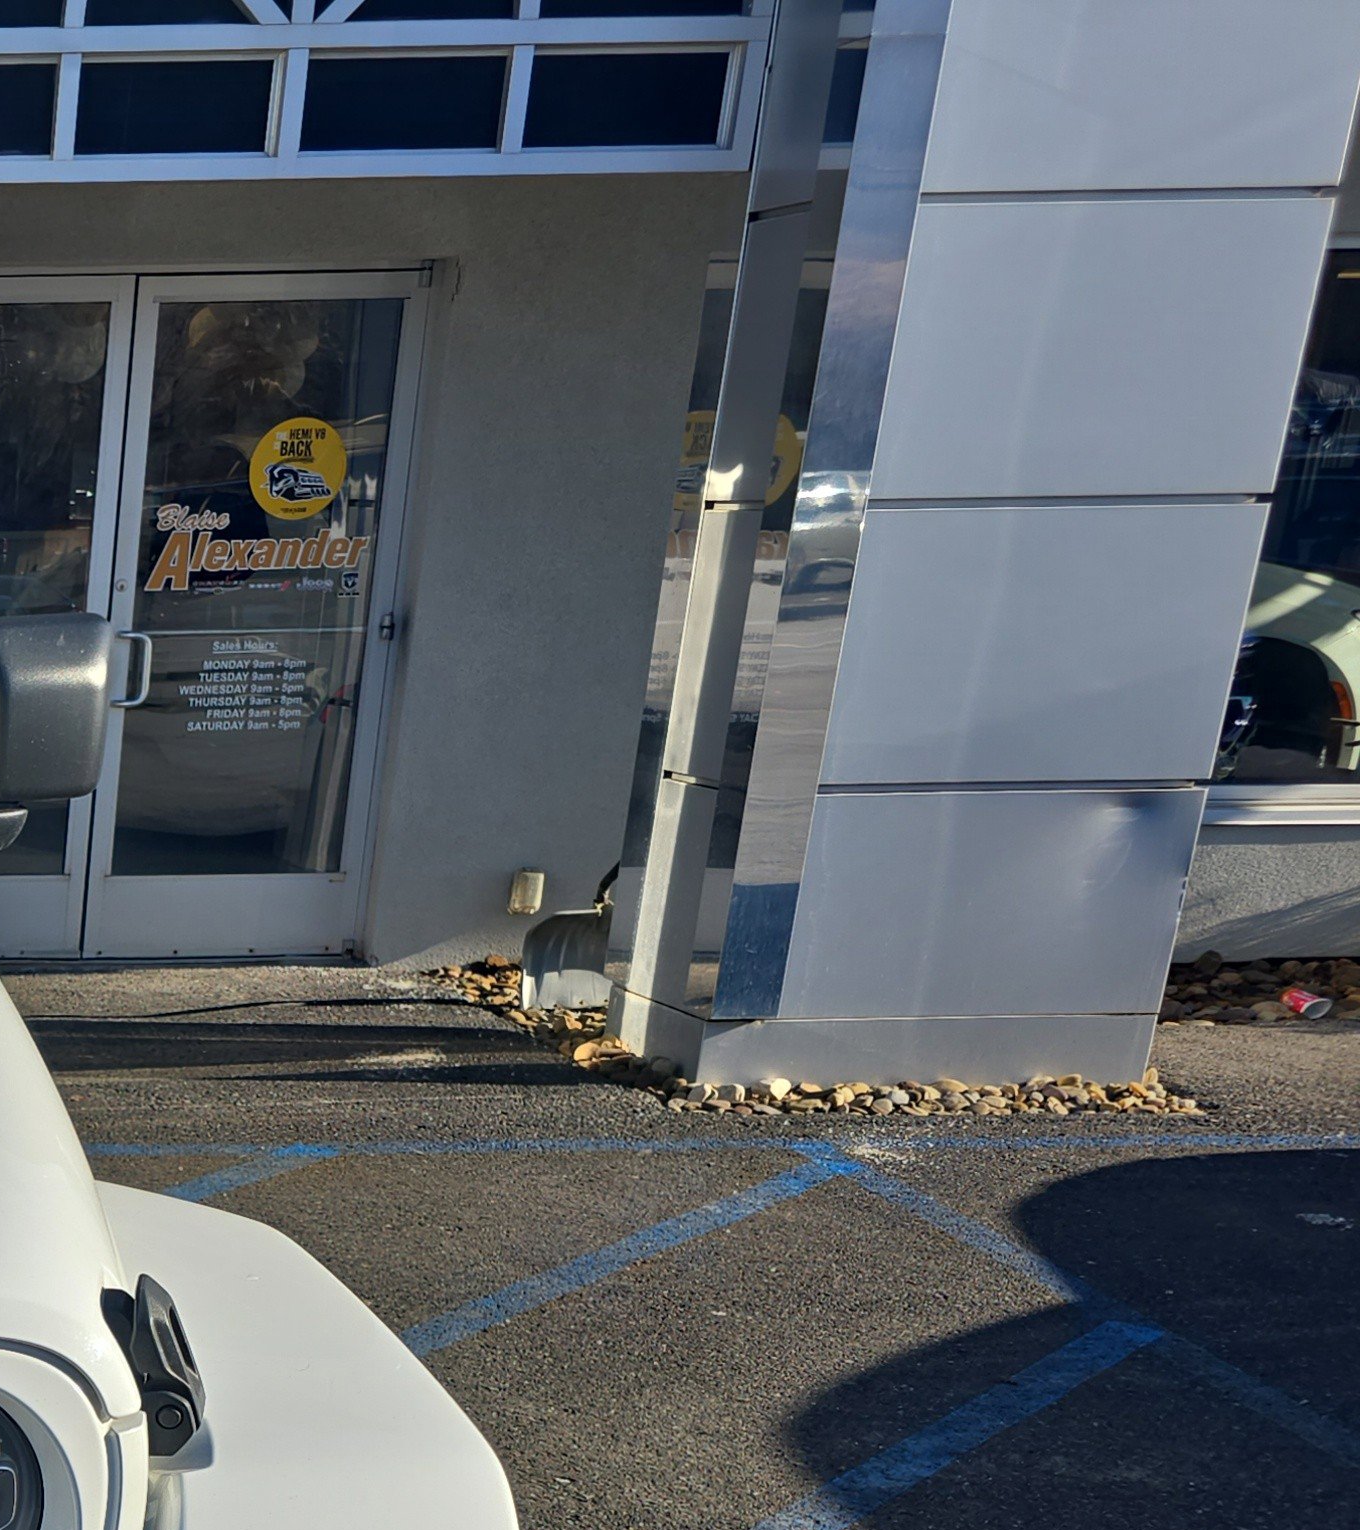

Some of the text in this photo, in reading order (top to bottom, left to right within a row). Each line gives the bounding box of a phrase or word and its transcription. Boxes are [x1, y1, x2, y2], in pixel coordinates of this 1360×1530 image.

[280, 440, 313, 457] BACK
[156, 504, 230, 531] Blaise
[144, 528, 371, 592] Alexander
[212, 640, 279, 651] Sales Hours:
[203, 660, 251, 670] MONDAY
[252, 659, 275, 669] 9am
[199, 672, 250, 683] TUESDAY
[251, 671, 274, 682] 9am
[178, 684, 249, 695] WEDNESDAY
[250, 683, 273, 695] 9am
[188, 697, 246, 707] THURSDAY
[248, 696, 271, 706] 9am
[206, 709, 246, 719] FRIDAY
[247, 708, 270, 718] 9am
[186, 721, 245, 732] SATURDAY
[246, 720, 269, 731] 9am
